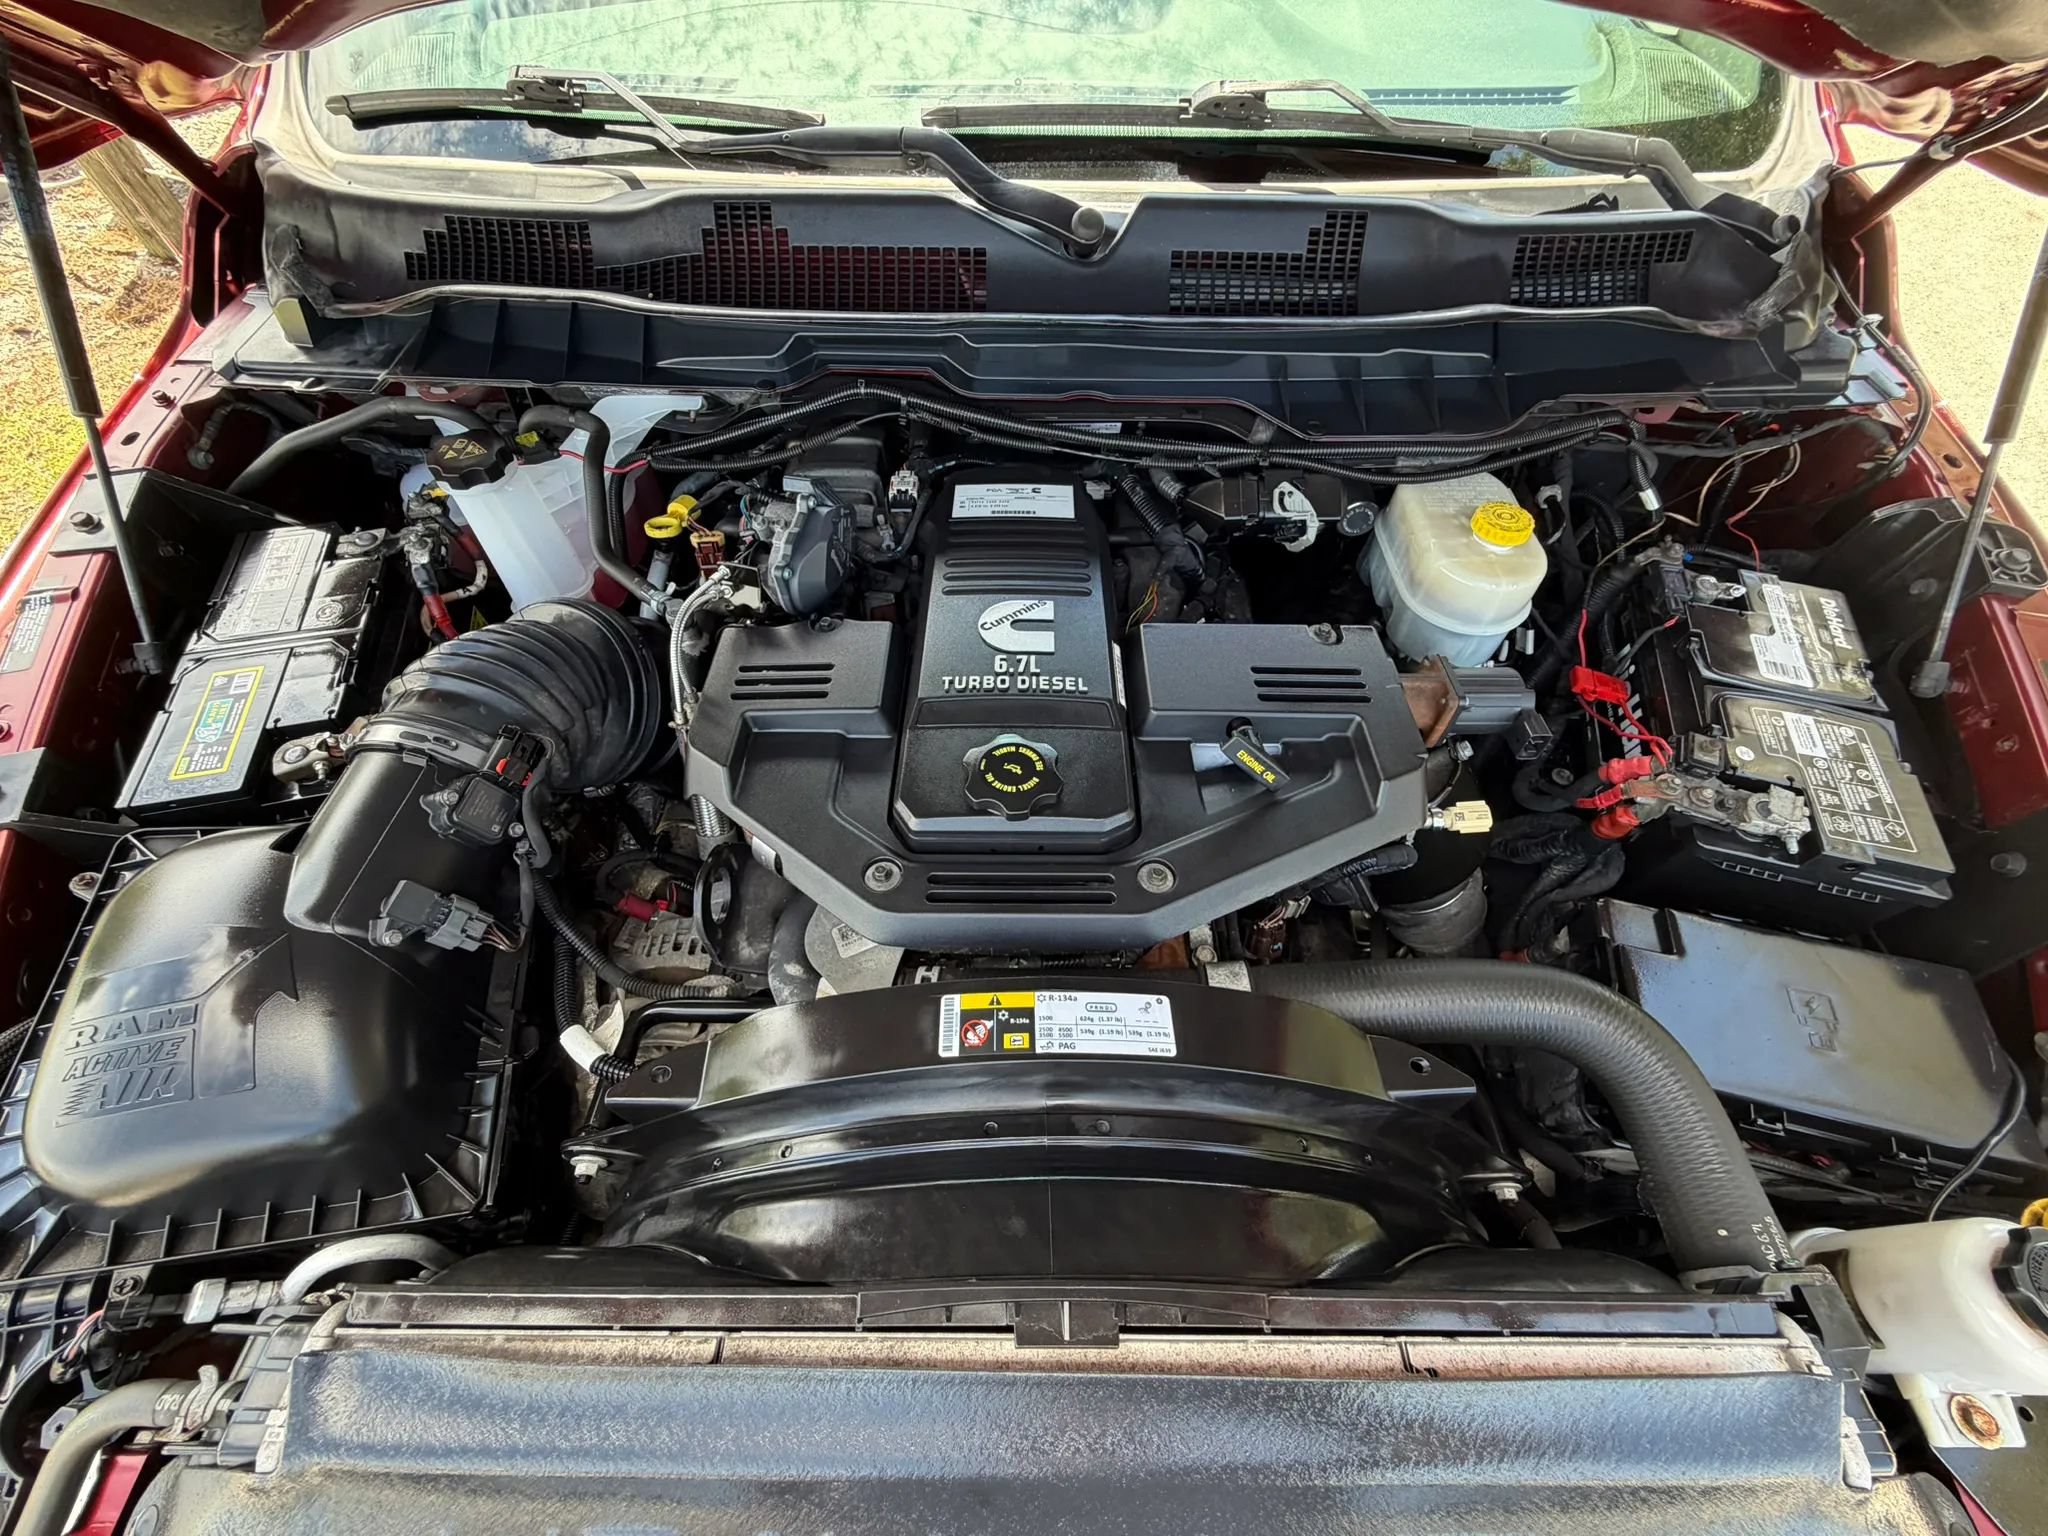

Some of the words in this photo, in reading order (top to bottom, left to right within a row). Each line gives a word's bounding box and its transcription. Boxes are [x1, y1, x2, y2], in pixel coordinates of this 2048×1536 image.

[980, 600, 1048, 631] Cummins
[1819, 597, 1853, 650] DieHard
[994, 655, 1041, 674] 6.7L
[942, 675, 1010, 691] TURBO
[1017, 675, 1089, 692] DIESEL
[1236, 749, 1266, 774] ENGINE
[1262, 771, 1276, 784] OIL
[1048, 994, 1078, 1002] R-134a
[64, 1003, 199, 1051] RAM
[62, 1036, 186, 1083] ACTIVE
[1058, 1042, 1076, 1050] PAG
[86, 1065, 186, 1111] AIR
[155, 1393, 185, 1410] RAD
